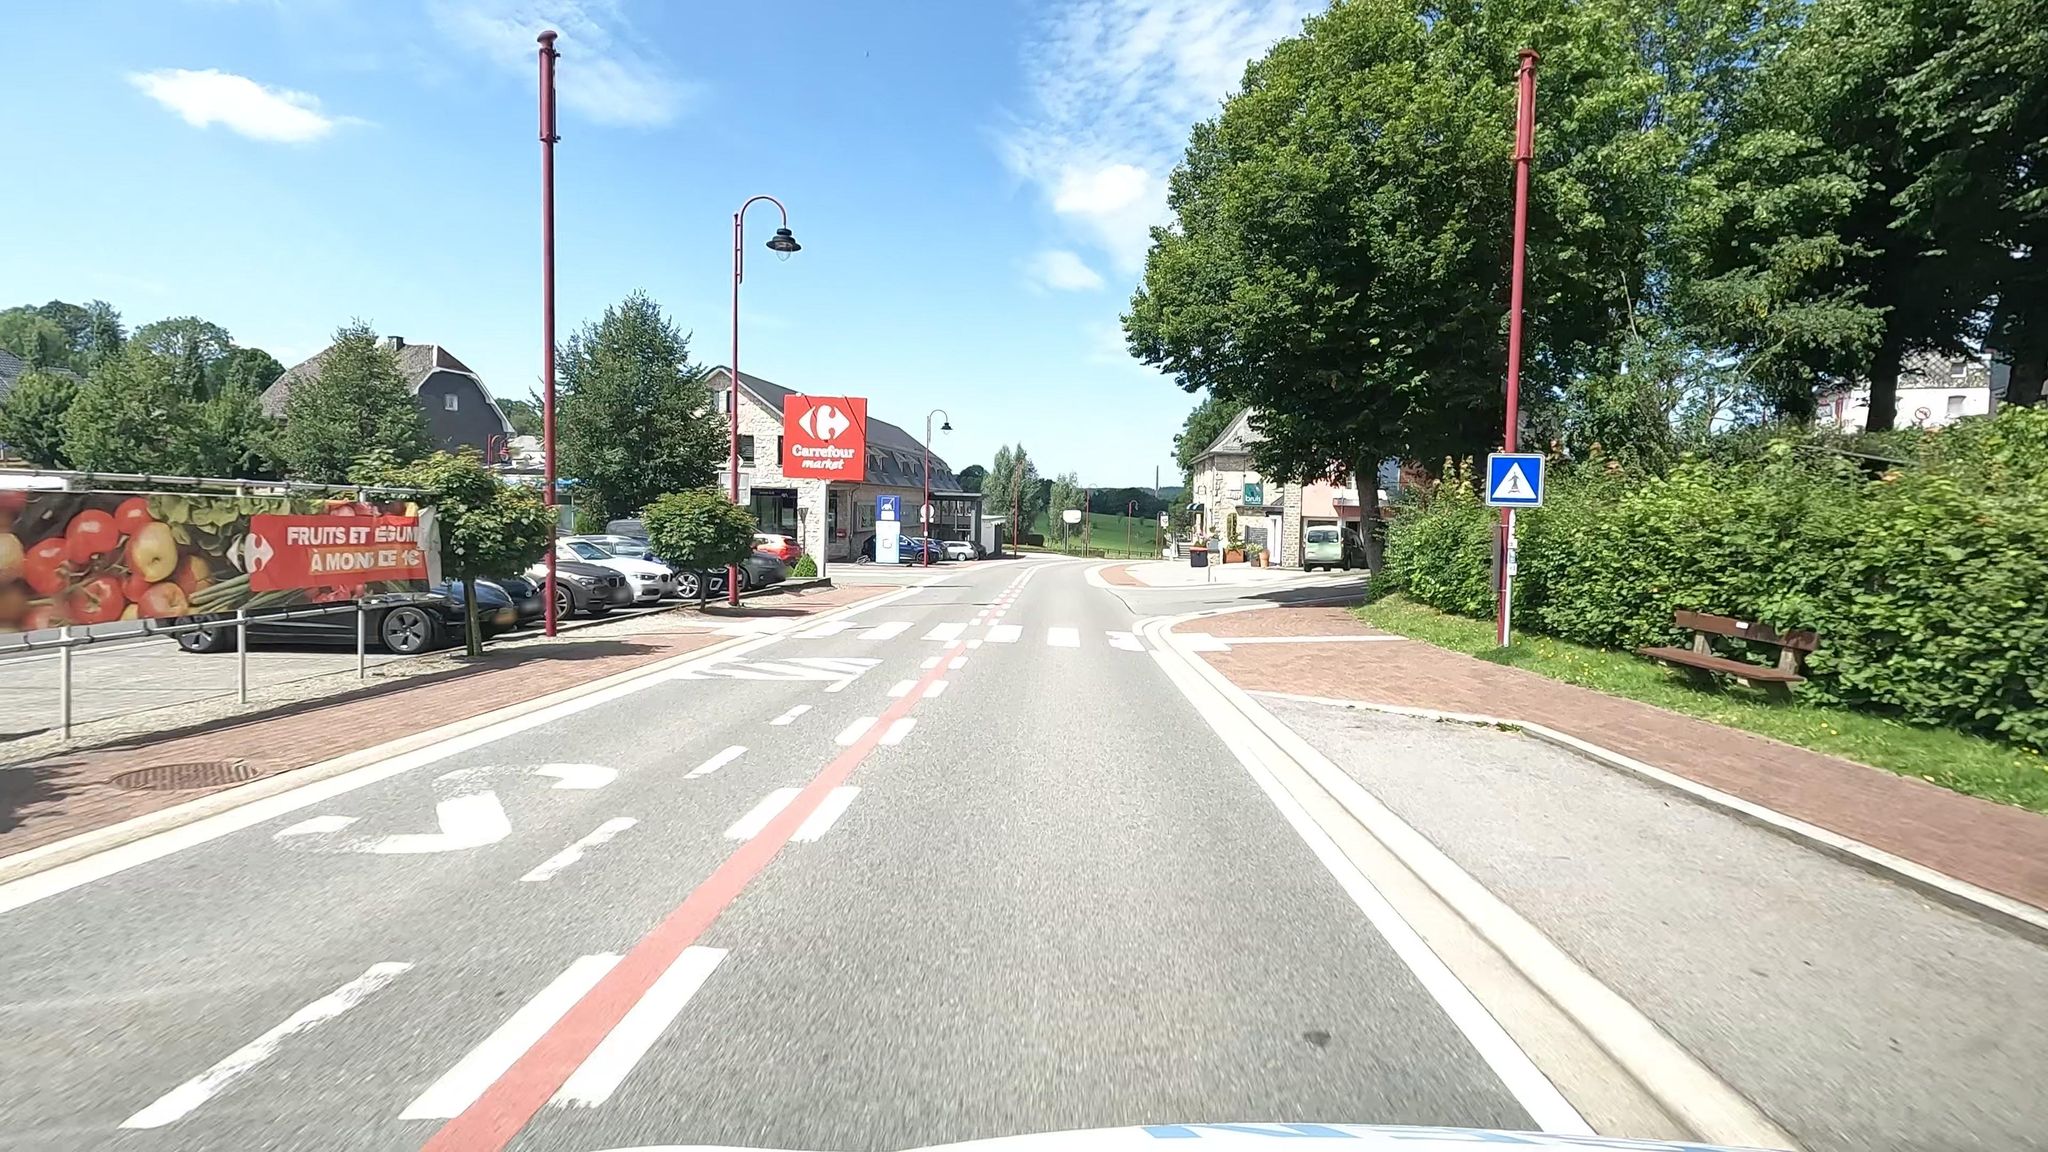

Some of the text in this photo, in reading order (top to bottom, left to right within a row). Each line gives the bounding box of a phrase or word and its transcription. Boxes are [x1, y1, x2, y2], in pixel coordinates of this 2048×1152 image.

[791, 444, 855, 458] Carrefour
[801, 459, 844, 470] market
[287, 526, 346, 545] FRUITS
[349, 526, 370, 544] ET
[311, 549, 322, 572] À
